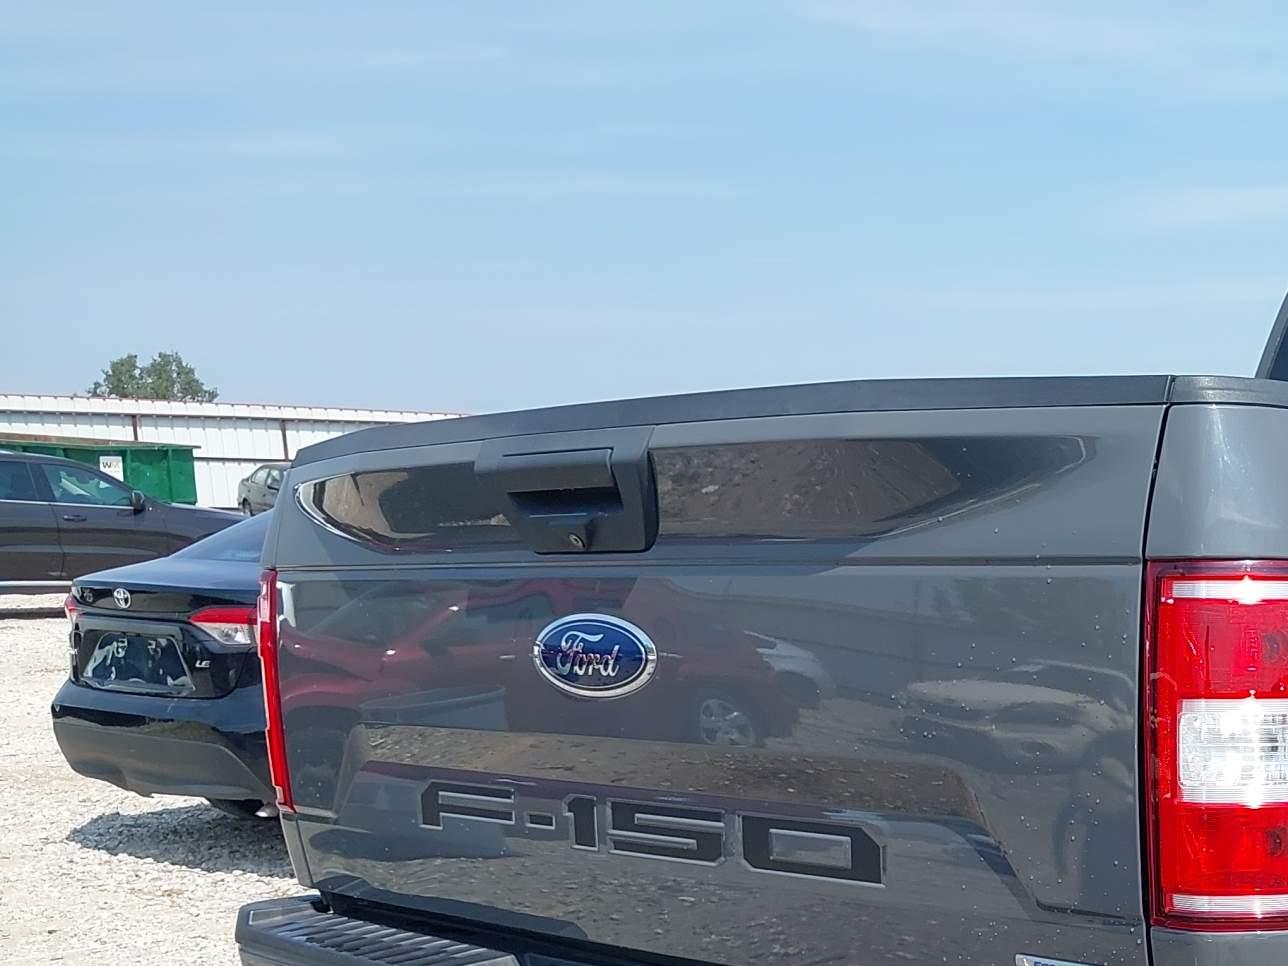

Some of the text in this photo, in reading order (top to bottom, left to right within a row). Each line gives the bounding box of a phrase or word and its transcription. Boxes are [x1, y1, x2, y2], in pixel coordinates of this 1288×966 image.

[195, 660, 211, 668] LE
[556, 630, 620, 677] Ford
[419, 778, 888, 888] F-150
